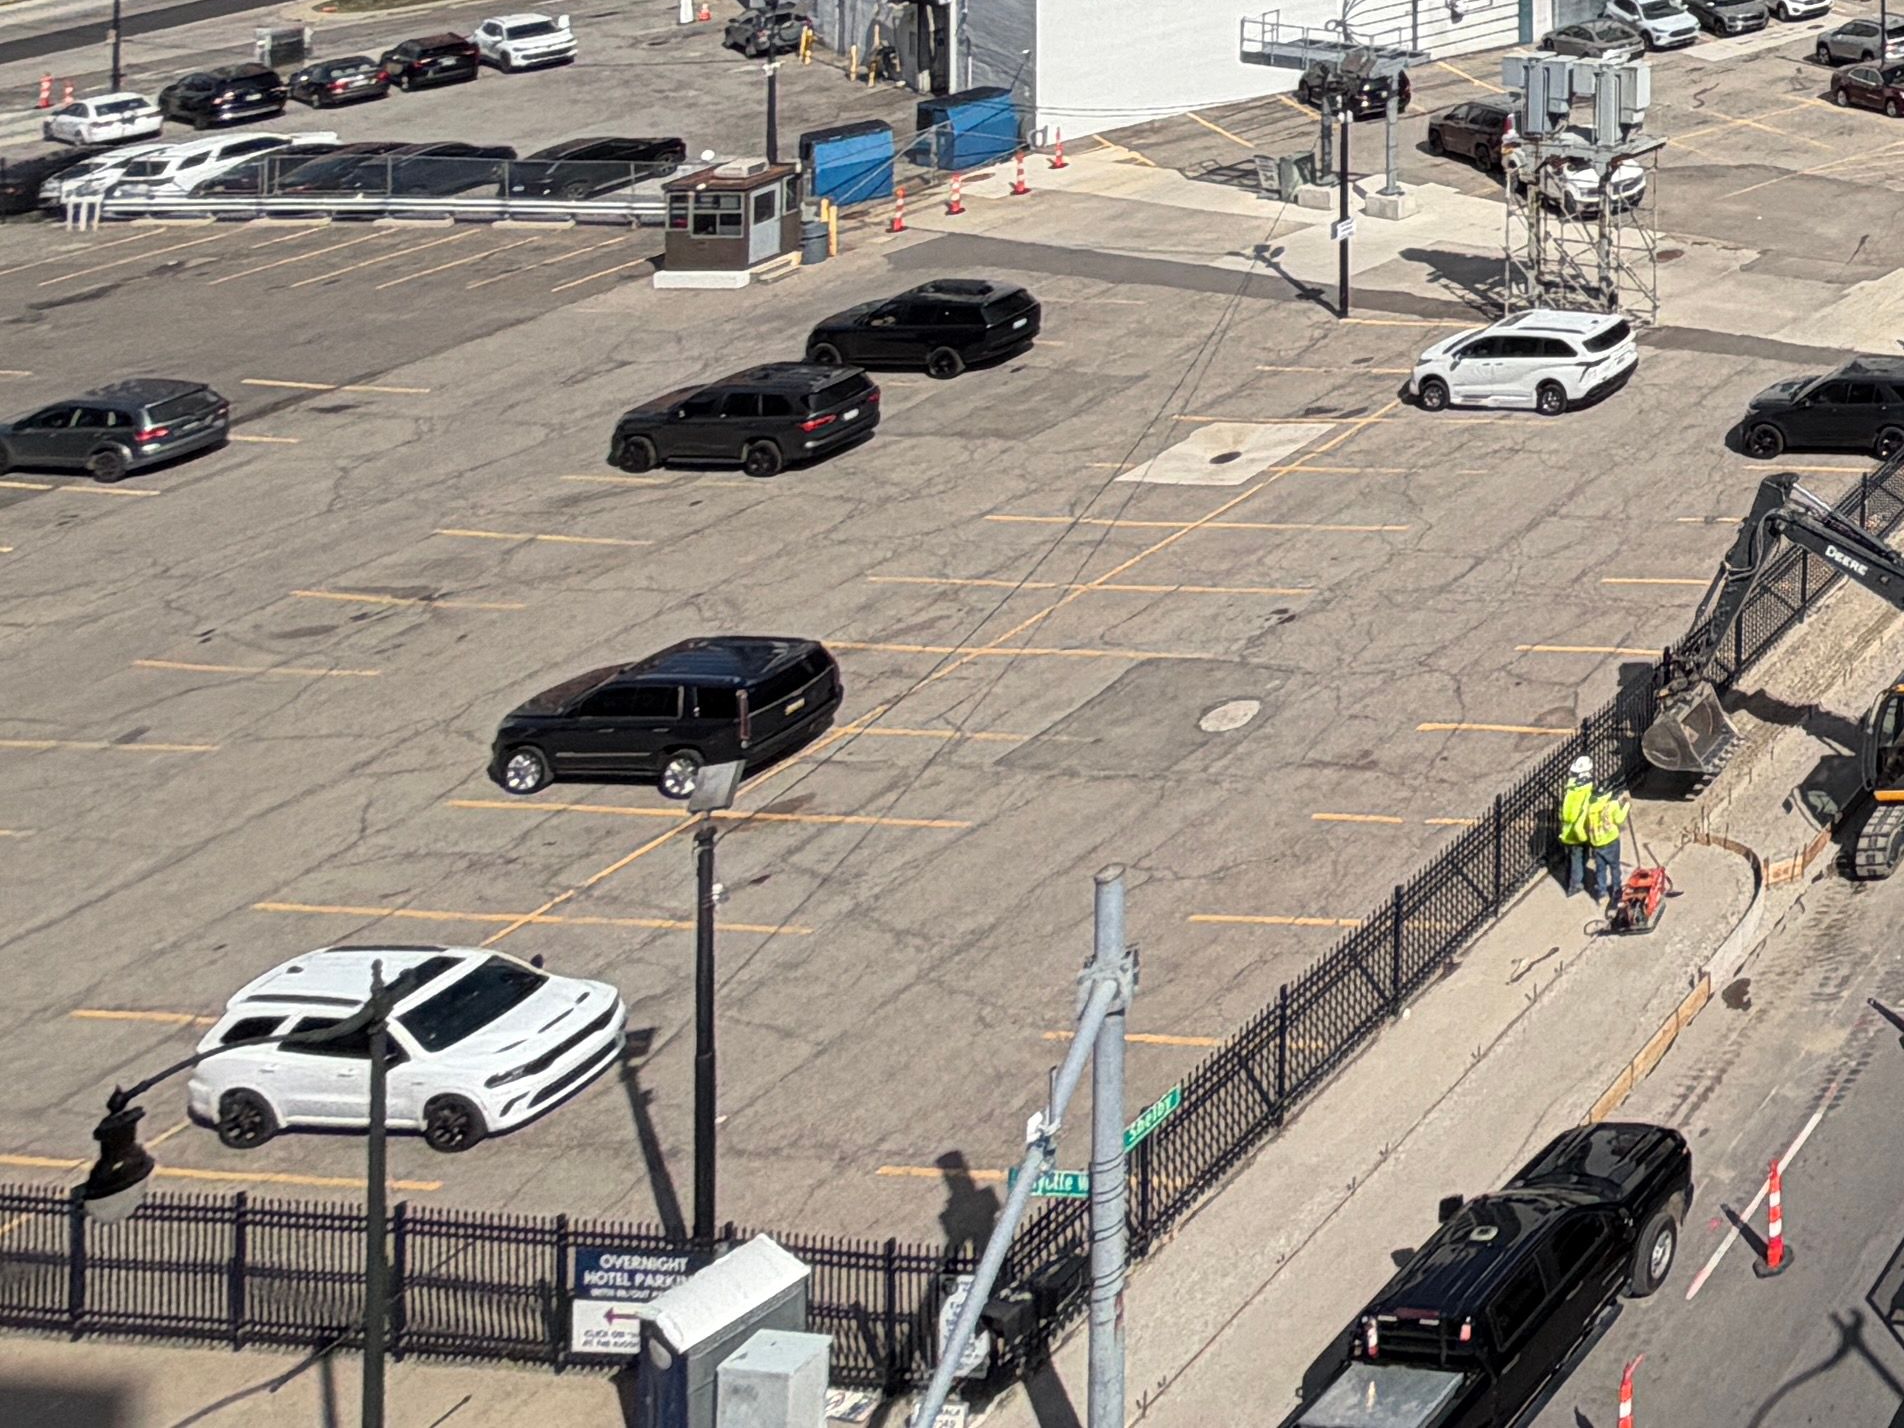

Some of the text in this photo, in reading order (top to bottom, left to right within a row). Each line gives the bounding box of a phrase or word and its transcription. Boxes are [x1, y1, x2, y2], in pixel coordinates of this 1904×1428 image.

[1825, 544, 1869, 576] DEERE
[1129, 1093, 1173, 1142] Shelby
[599, 1253, 689, 1273] OVERNIGHT
[583, 1270, 632, 1286] HOTEL
